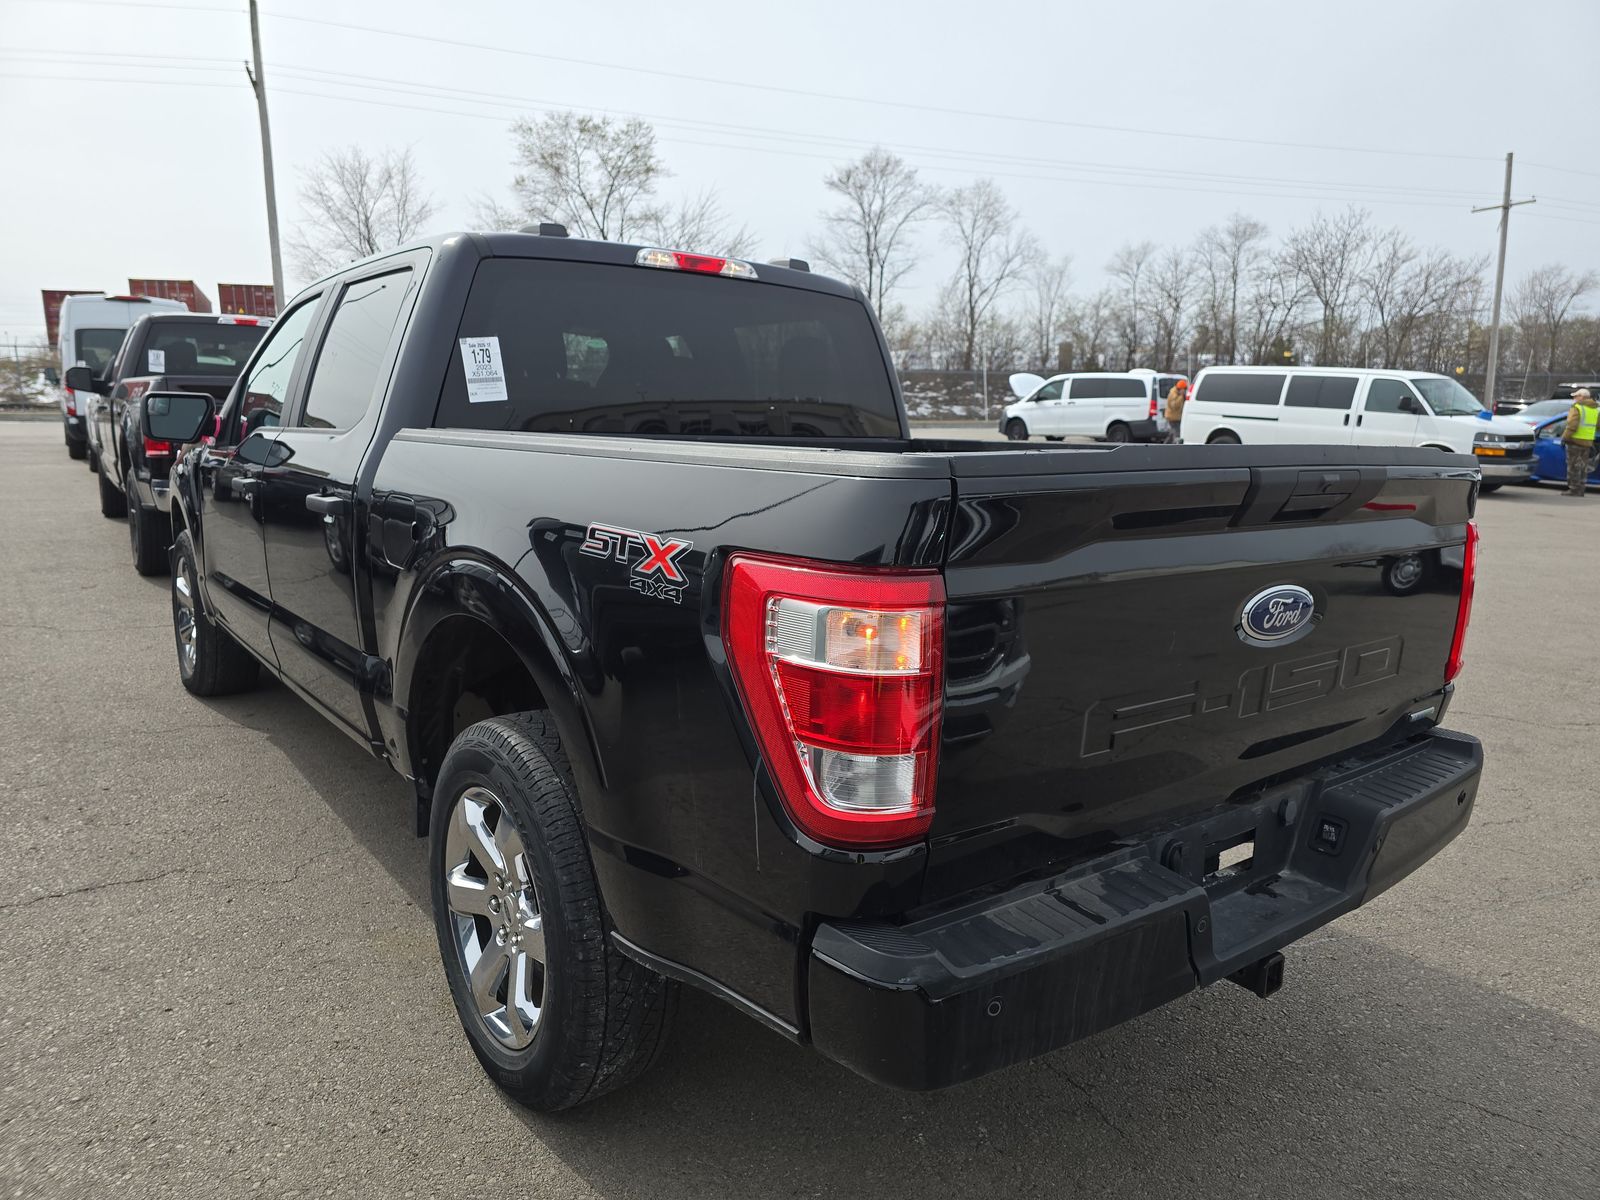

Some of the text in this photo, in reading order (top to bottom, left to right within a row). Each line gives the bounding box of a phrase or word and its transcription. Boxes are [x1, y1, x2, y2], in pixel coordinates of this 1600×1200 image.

[472, 348, 492, 364] 1:79
[579, 521, 694, 589] STX
[1263, 597, 1303, 629] Ford
[1080, 634, 1404, 758] F-150
